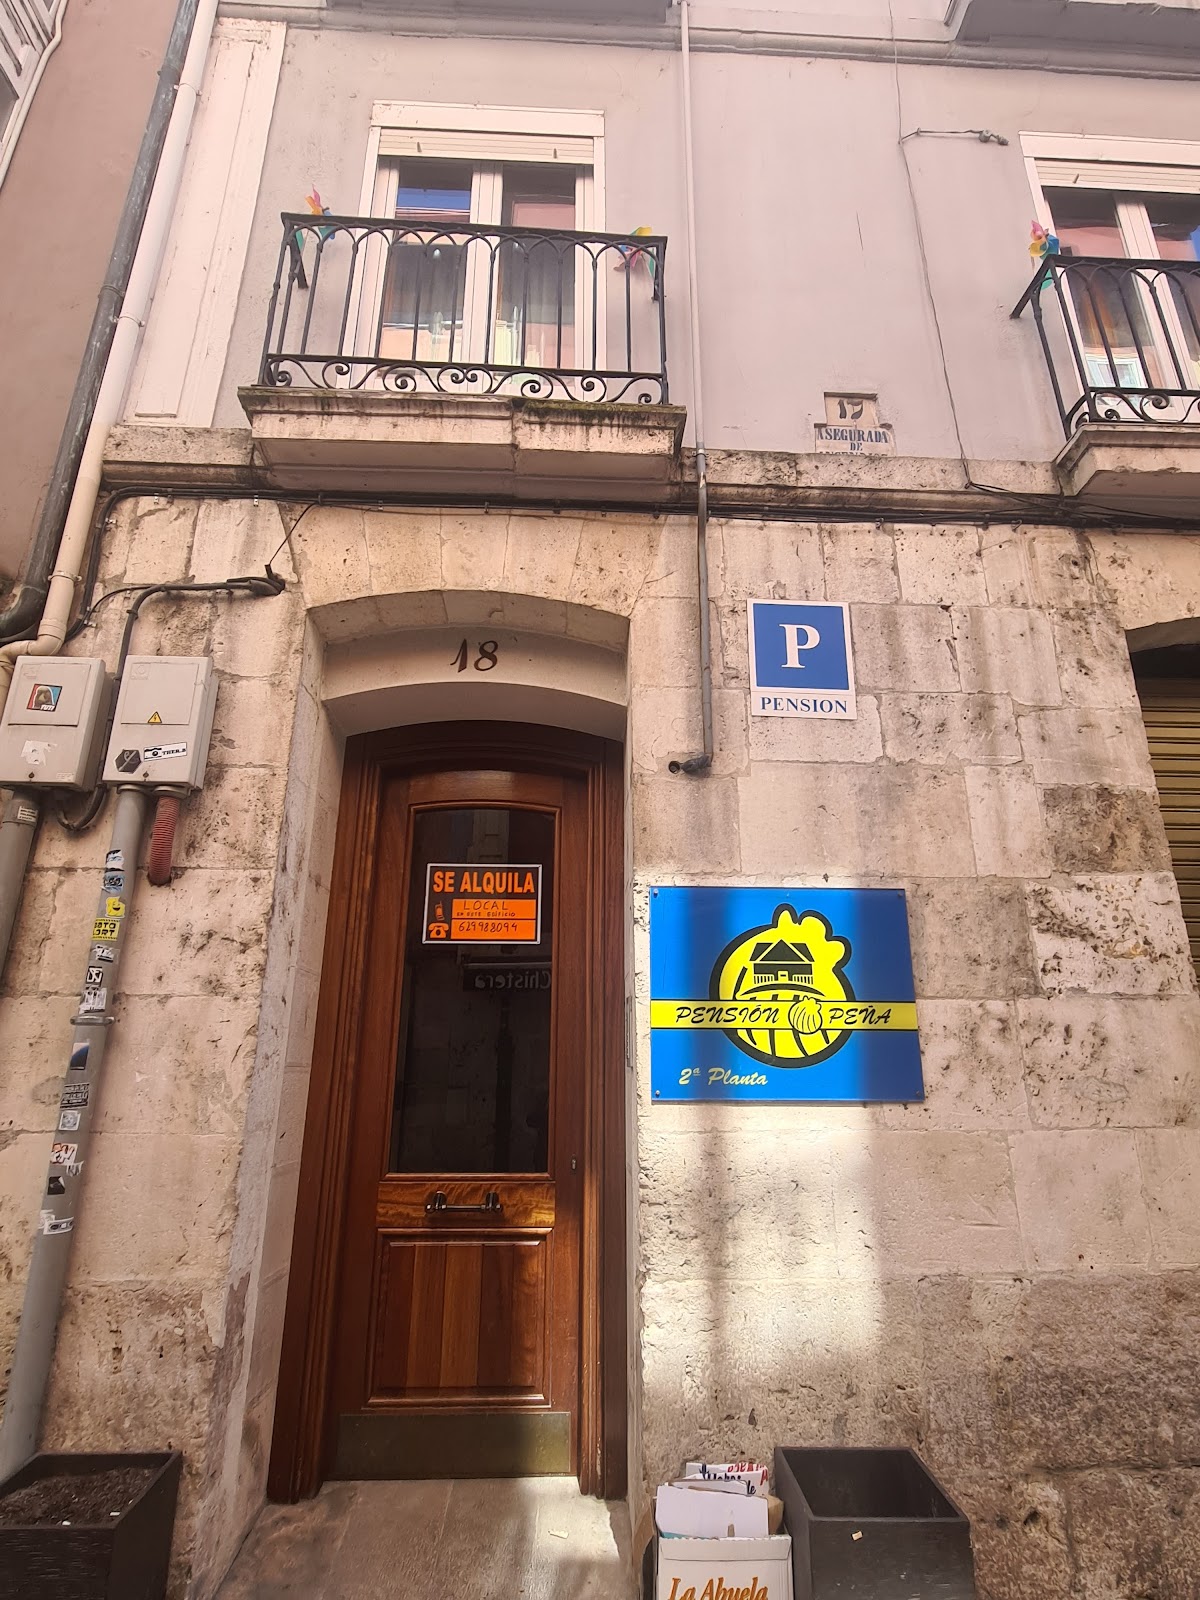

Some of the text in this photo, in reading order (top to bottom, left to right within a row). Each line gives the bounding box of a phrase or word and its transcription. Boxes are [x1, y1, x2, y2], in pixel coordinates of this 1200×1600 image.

[838, 399, 864, 420] 17
[817, 428, 888, 444] ASEGURADA
[850, 442, 863, 452] DE
[450, 638, 499, 673] 18
[779, 624, 820, 669] P
[760, 697, 848, 714] PENSION
[433, 871, 535, 895] SE ALQUILA
[463, 900, 510, 911] LOCAL
[675, 1004, 892, 1026] PENSIÓN PEÑA
[678, 1067, 769, 1086] 2ª Planta
[667, 1576, 769, 1600] La Abuela
